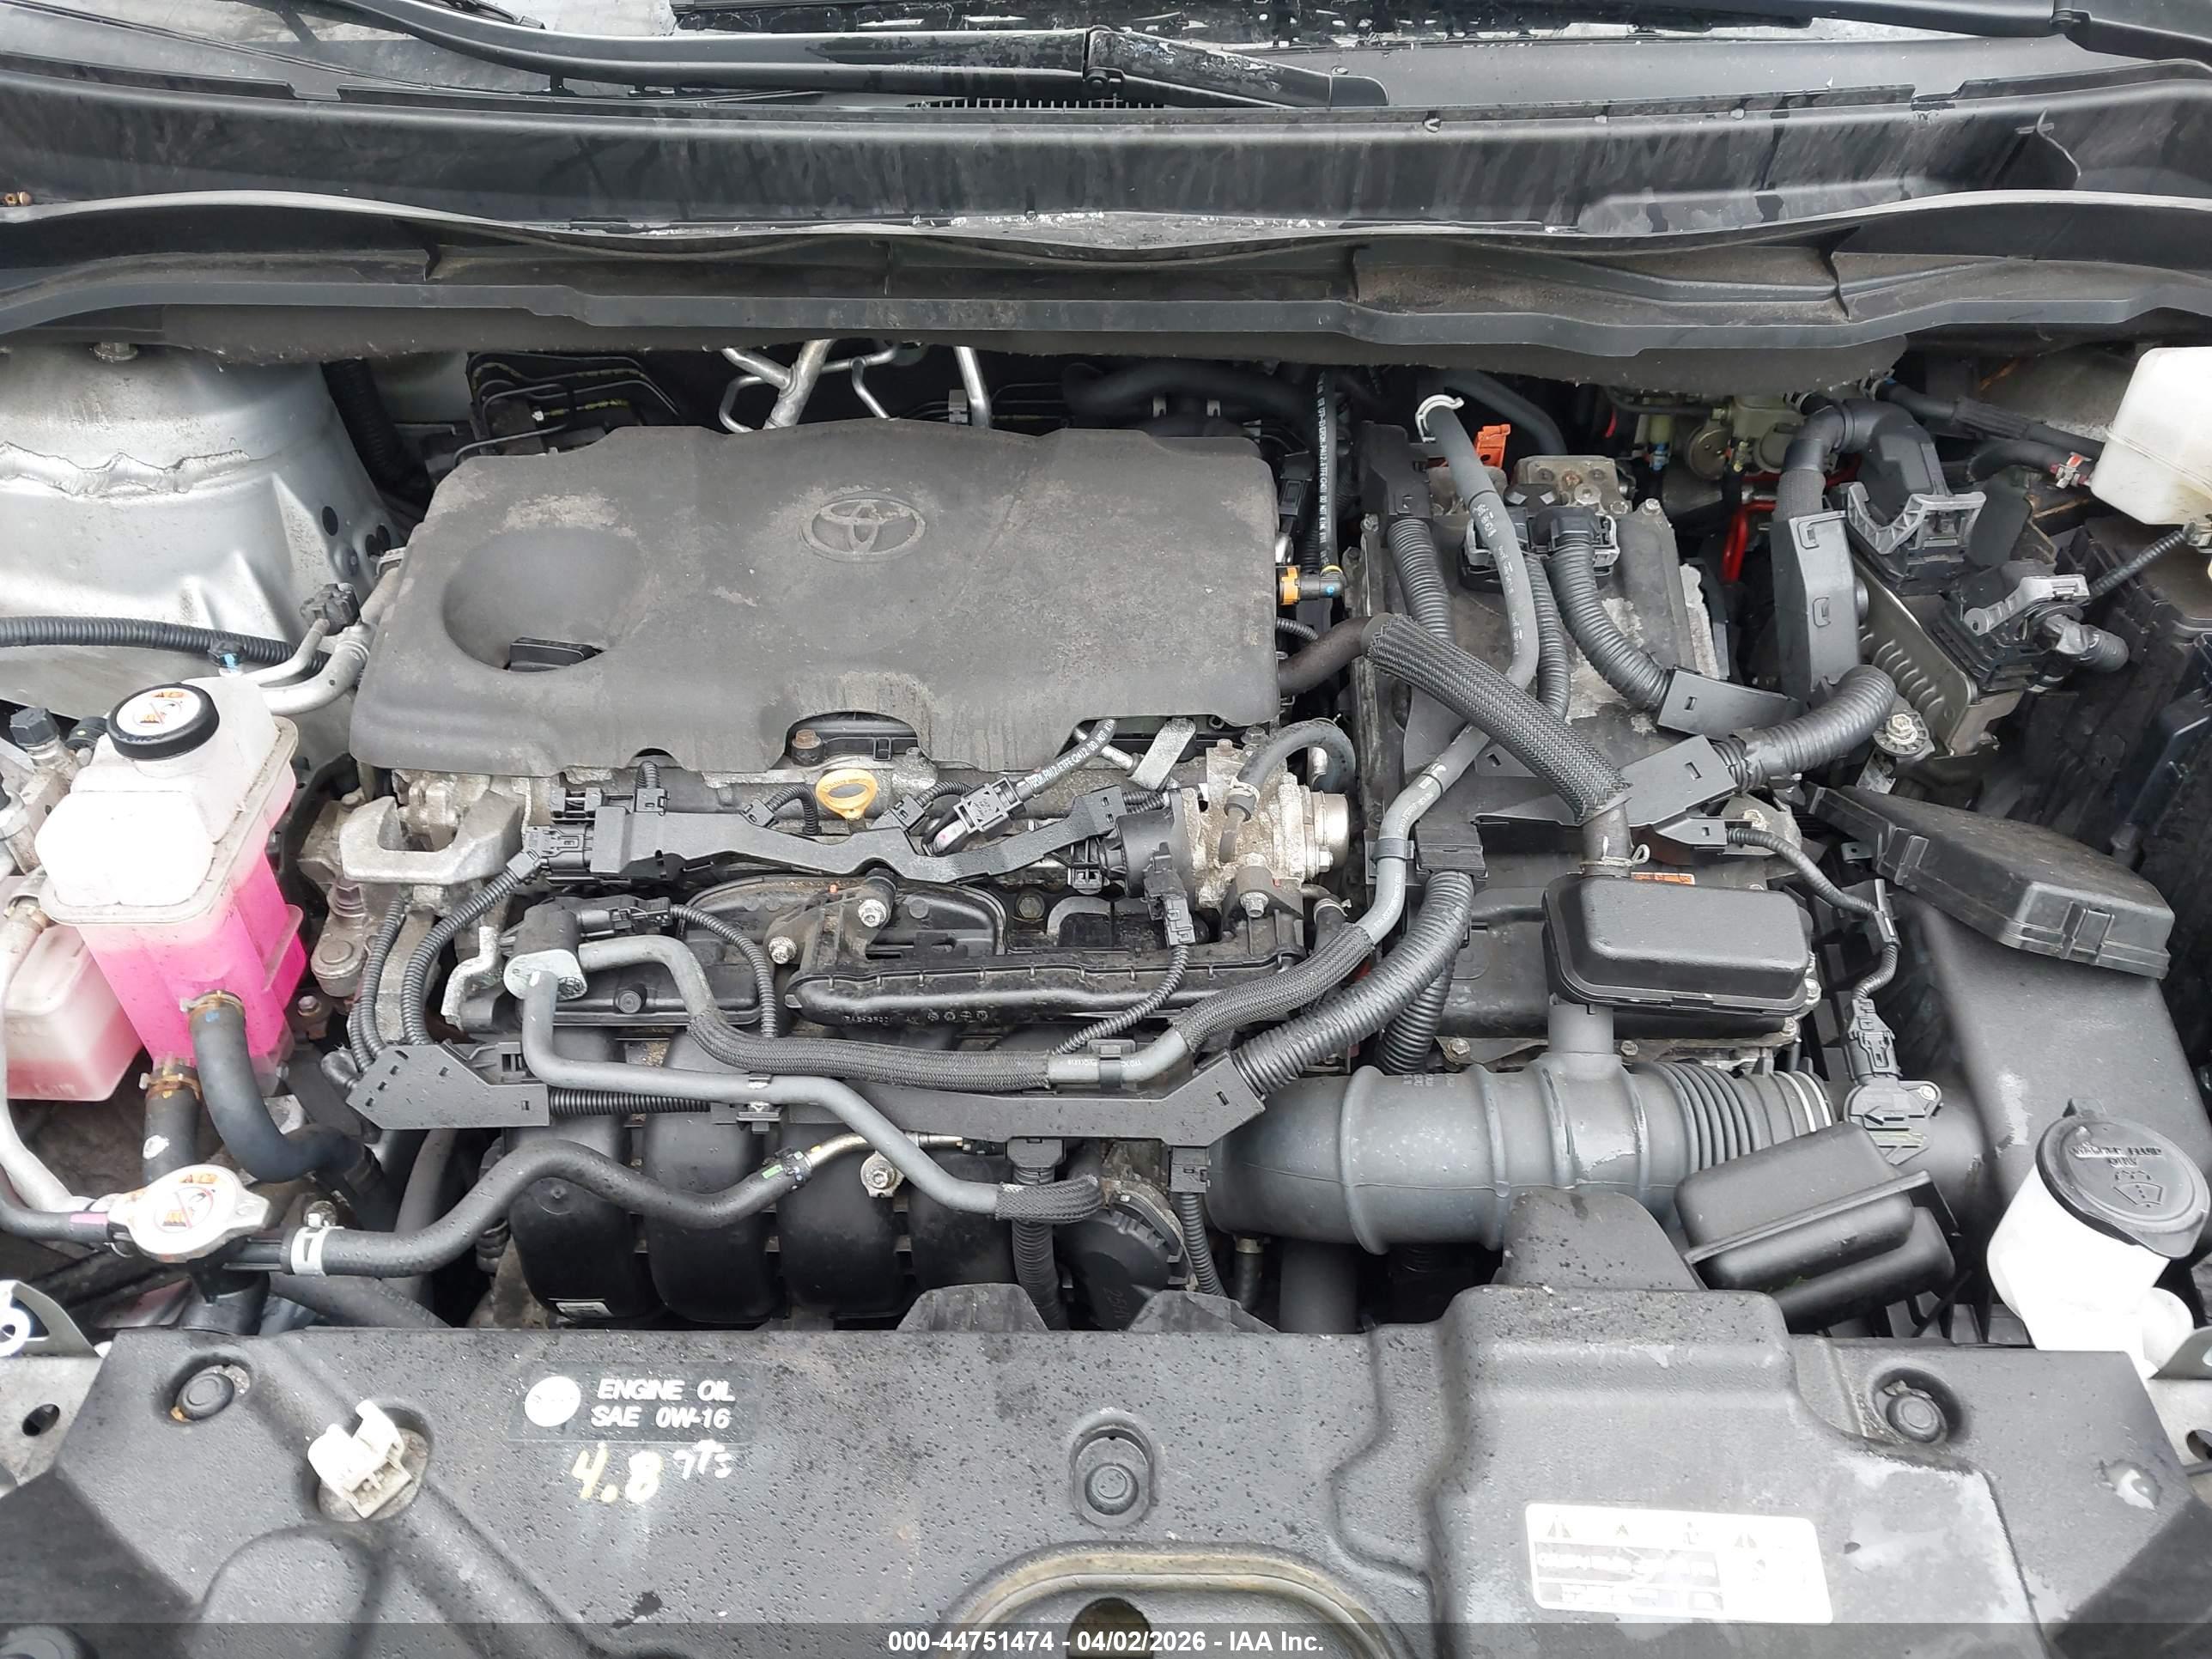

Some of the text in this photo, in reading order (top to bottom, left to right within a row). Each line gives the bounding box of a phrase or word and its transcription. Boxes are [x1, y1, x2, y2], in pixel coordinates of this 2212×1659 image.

[598, 1378, 685, 1401] ENGINE
[696, 1380, 736, 1402] OIL
[591, 1406, 730, 1429] SAE 0W-16
[571, 1442, 663, 1503] 4.8
